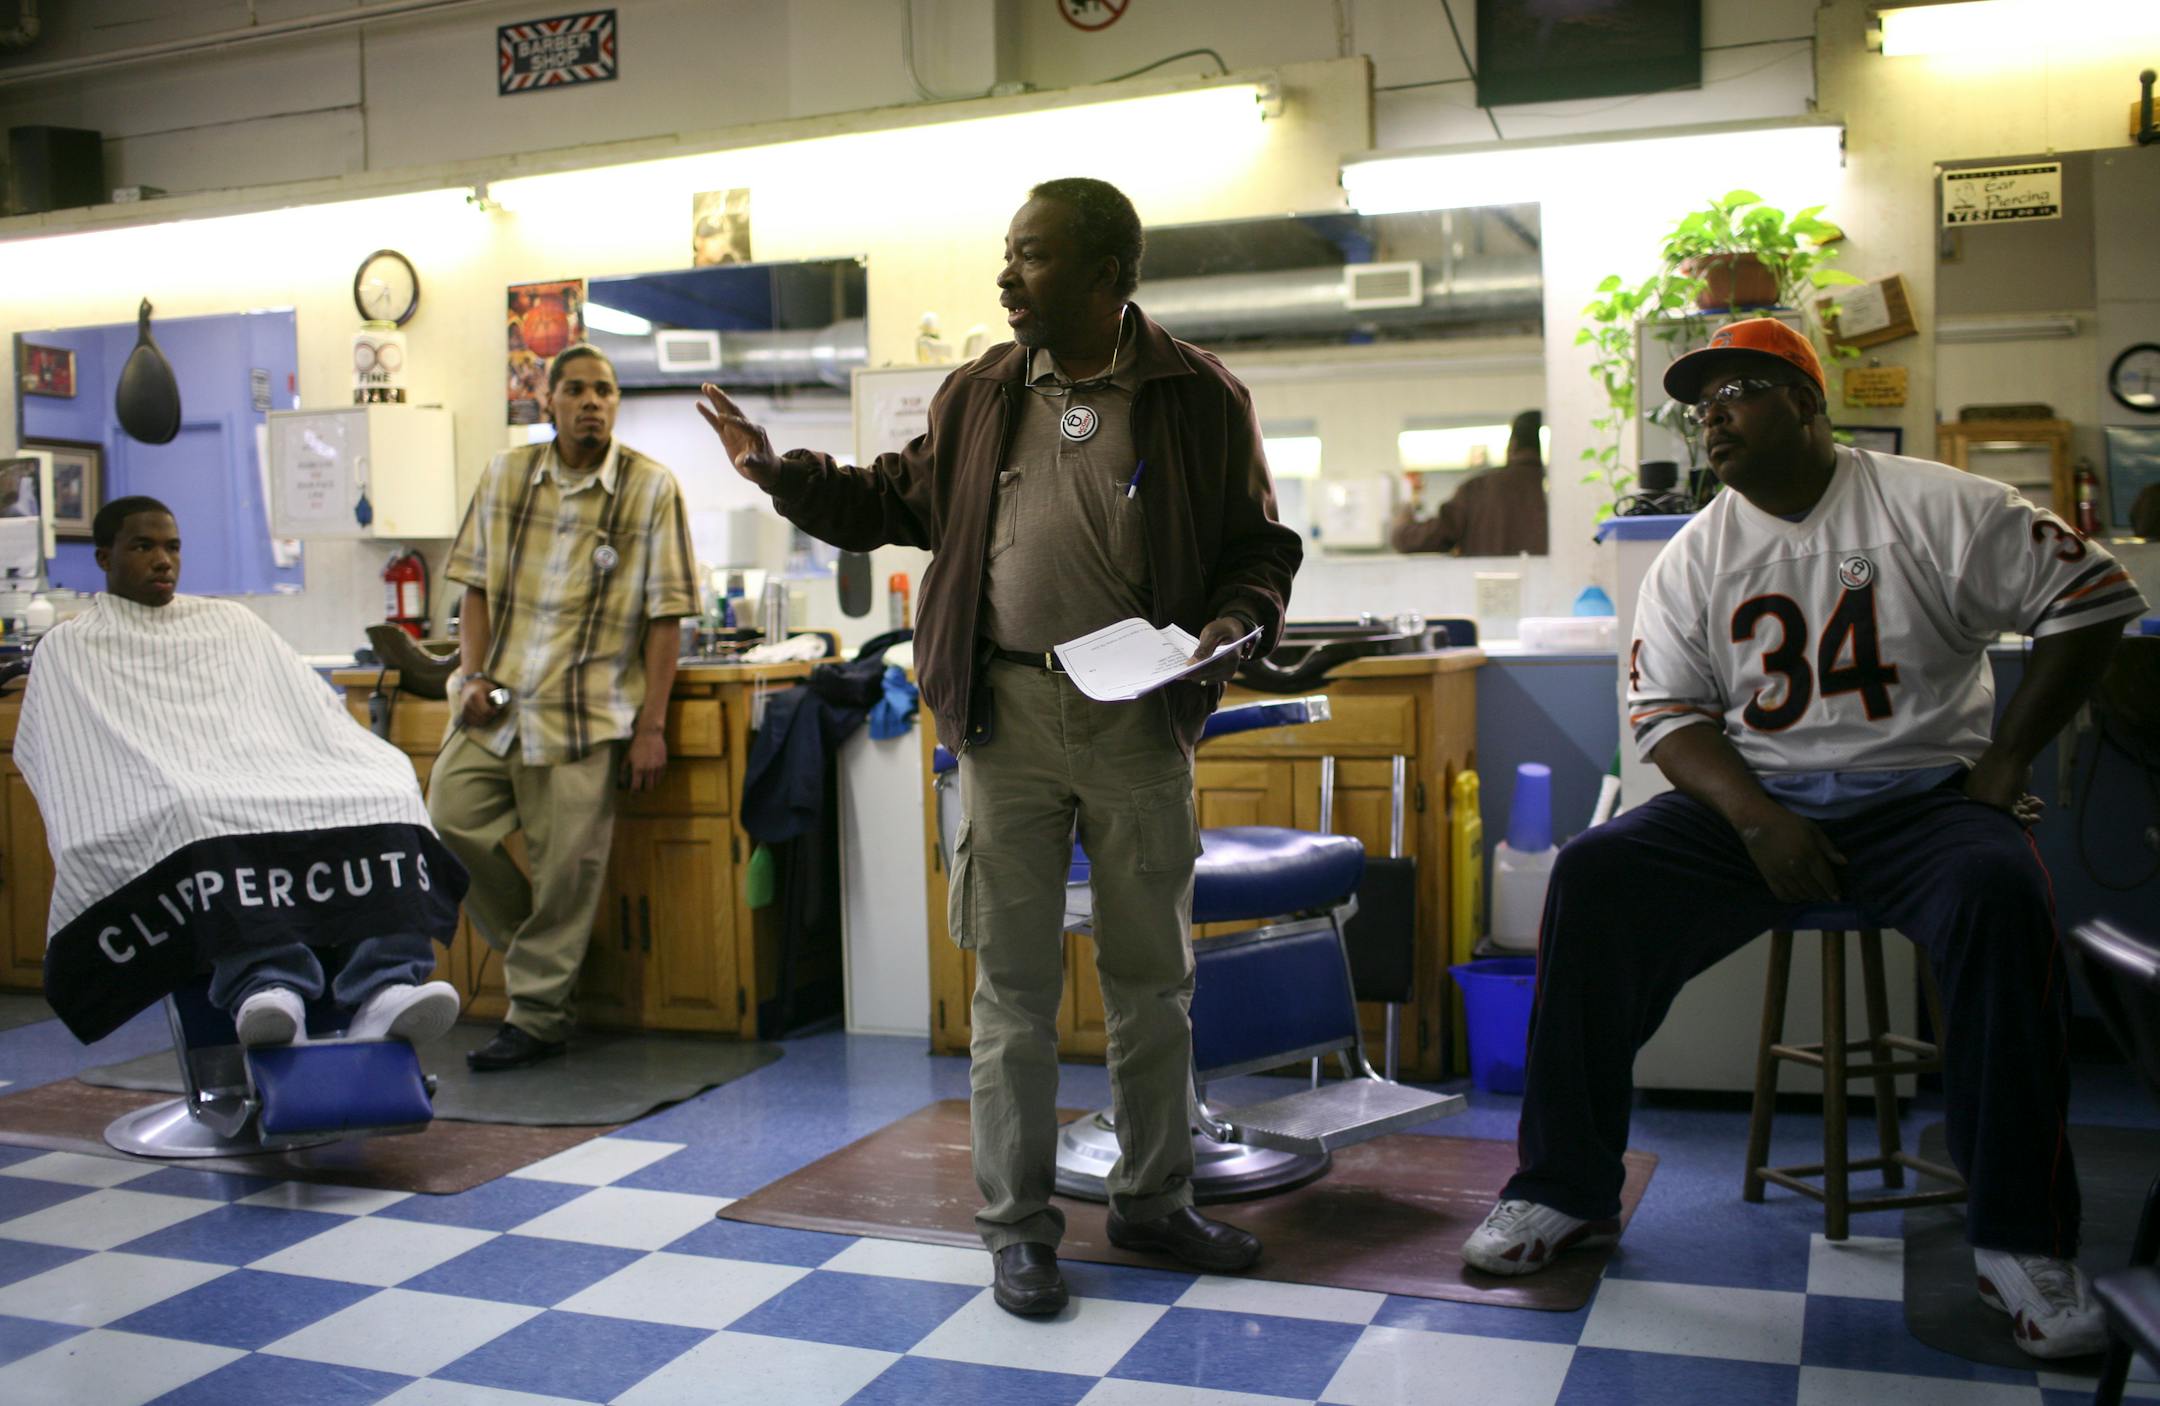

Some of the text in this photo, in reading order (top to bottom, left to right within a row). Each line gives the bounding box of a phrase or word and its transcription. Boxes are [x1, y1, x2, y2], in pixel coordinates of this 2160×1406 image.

[518, 32, 592, 58] BARBER
[531, 50, 580, 70] SHOP
[1984, 177, 2016, 193] Ear
[1985, 190, 2051, 211] Piercing
[1731, 584, 1900, 734] 34
